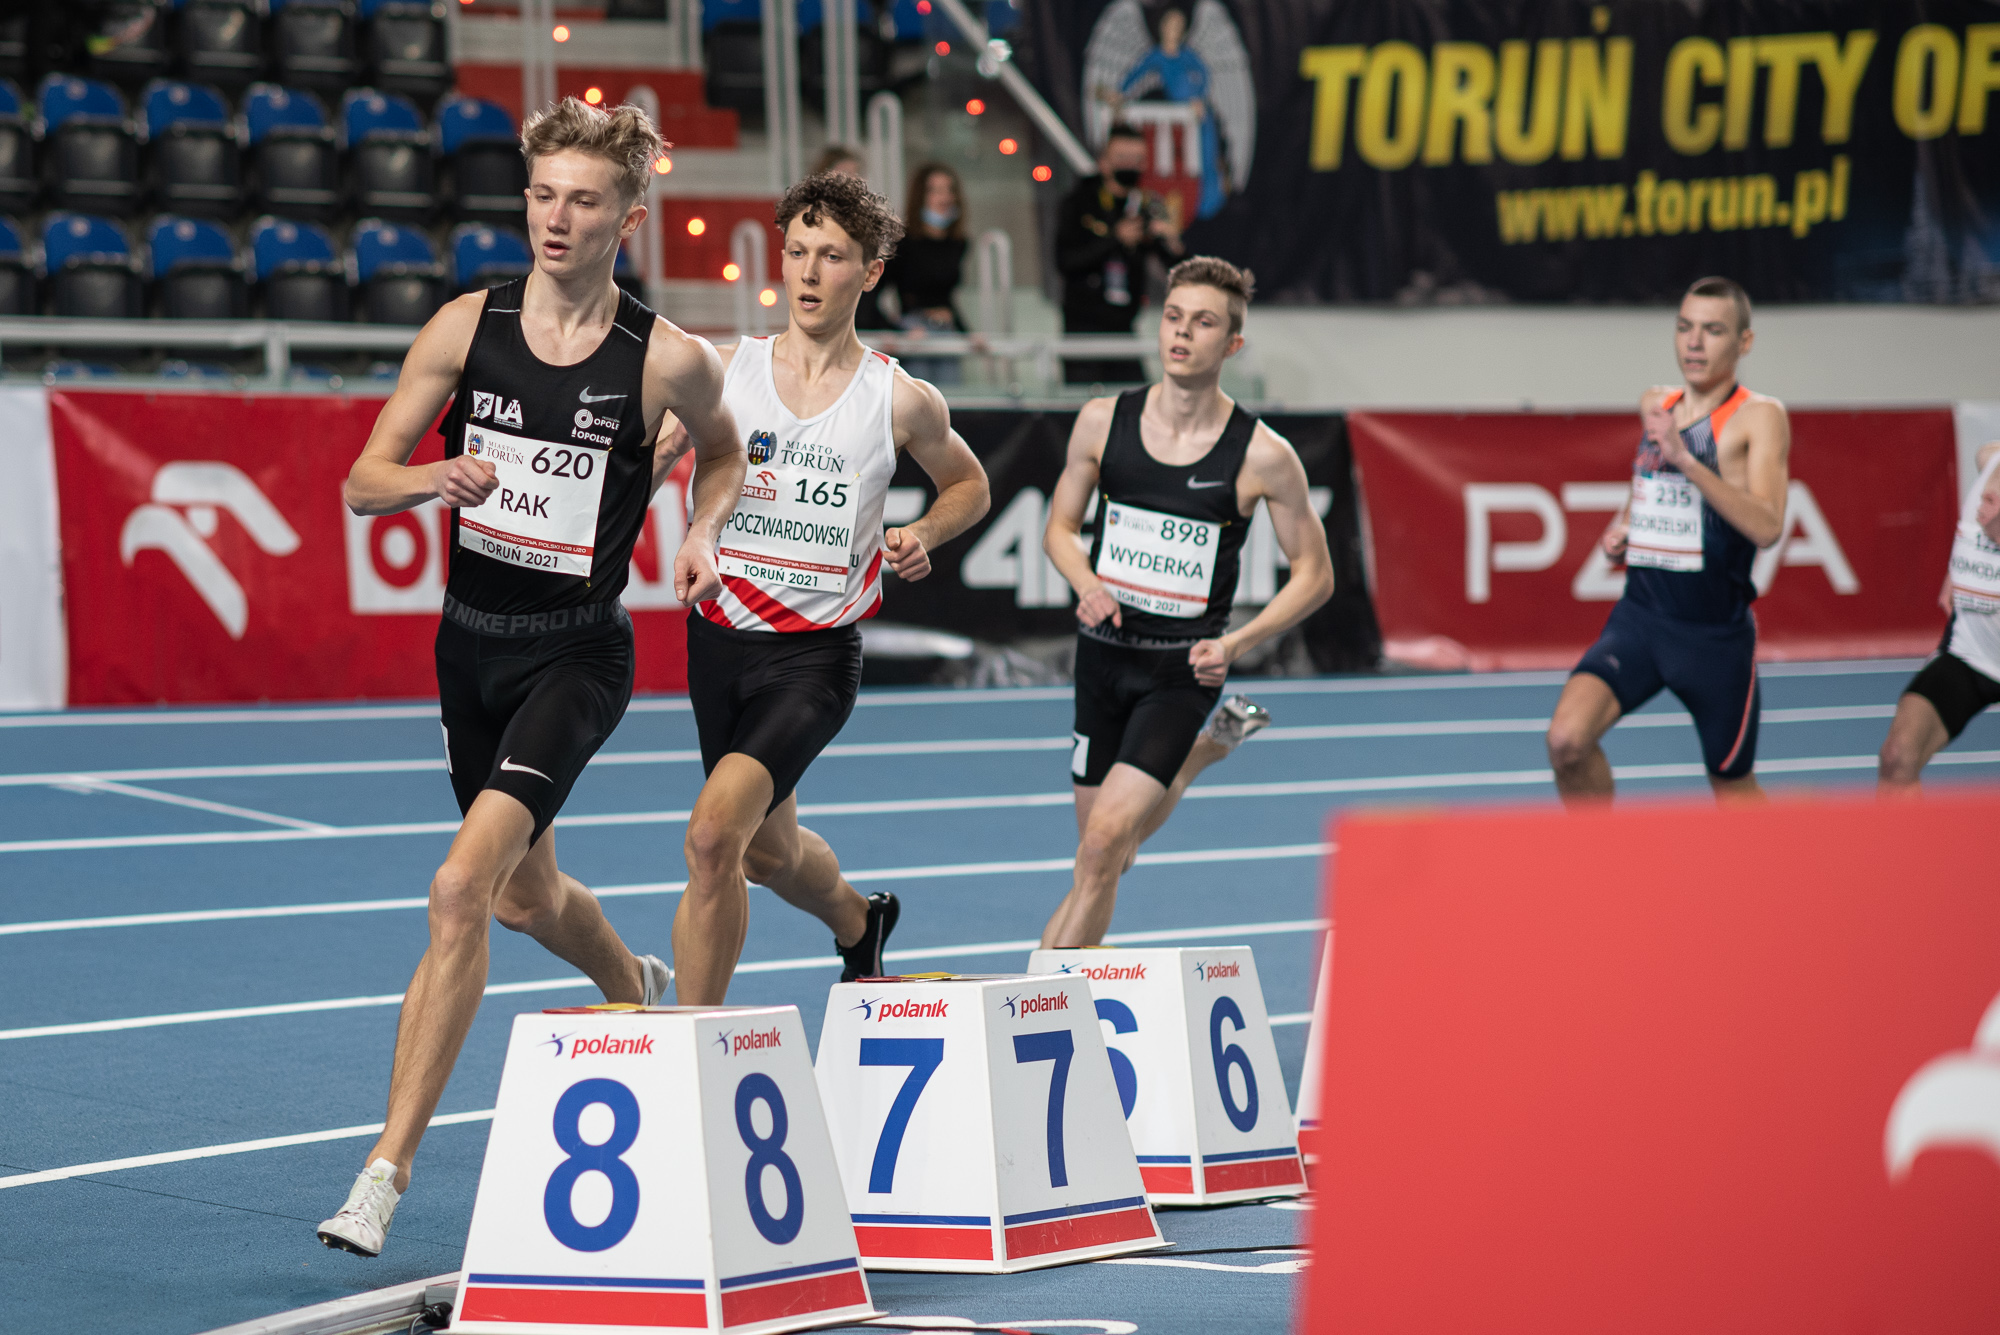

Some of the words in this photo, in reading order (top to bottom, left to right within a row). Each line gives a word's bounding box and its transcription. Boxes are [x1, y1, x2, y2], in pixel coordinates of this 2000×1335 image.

[1301, 6, 1634, 171] TORUŃ
[1662, 28, 1877, 156] CITY
[1892, 22, 2000, 140] OF
[1495, 154, 1851, 245] www.torun.pl
[594, 418, 620, 431] OPOLE
[486, 448, 524, 465] TORUŃ
[488, 440, 516, 453] MIASTO
[781, 449, 846, 474] TORUŃ
[785, 440, 833, 455] MIASTO
[531, 447, 594, 480] 620
[500, 488, 551, 519] RAK
[795, 478, 848, 508] 165
[1656, 485, 1692, 508] 235
[727, 511, 850, 548] POCZWARDOWSKI
[1160, 519, 1209, 546] 898
[481, 537, 522, 562] TORUŃ
[524, 551, 559, 569] 2021
[1110, 543, 1203, 580] WYDERKA
[744, 564, 785, 583] TORUŃ
[788, 572, 819, 587] 2021
[454, 604, 506, 634] NIKE
[509, 608, 569, 634] PRO
[1154, 600, 1181, 613] 2021
[1081, 963, 1148, 981] polanik
[1206, 961, 1242, 983] polanik
[878, 998, 949, 1022] polanik
[1020, 991, 1069, 1019] polanik
[571, 1033, 655, 1060] polanik
[733, 1026, 782, 1057] polanik
[1209, 996, 1260, 1133] 6
[859, 1037, 945, 1194] 7
[1012, 1029, 1075, 1189] 7
[543, 1077, 641, 1253] 8
[734, 1072, 804, 1246] 8
